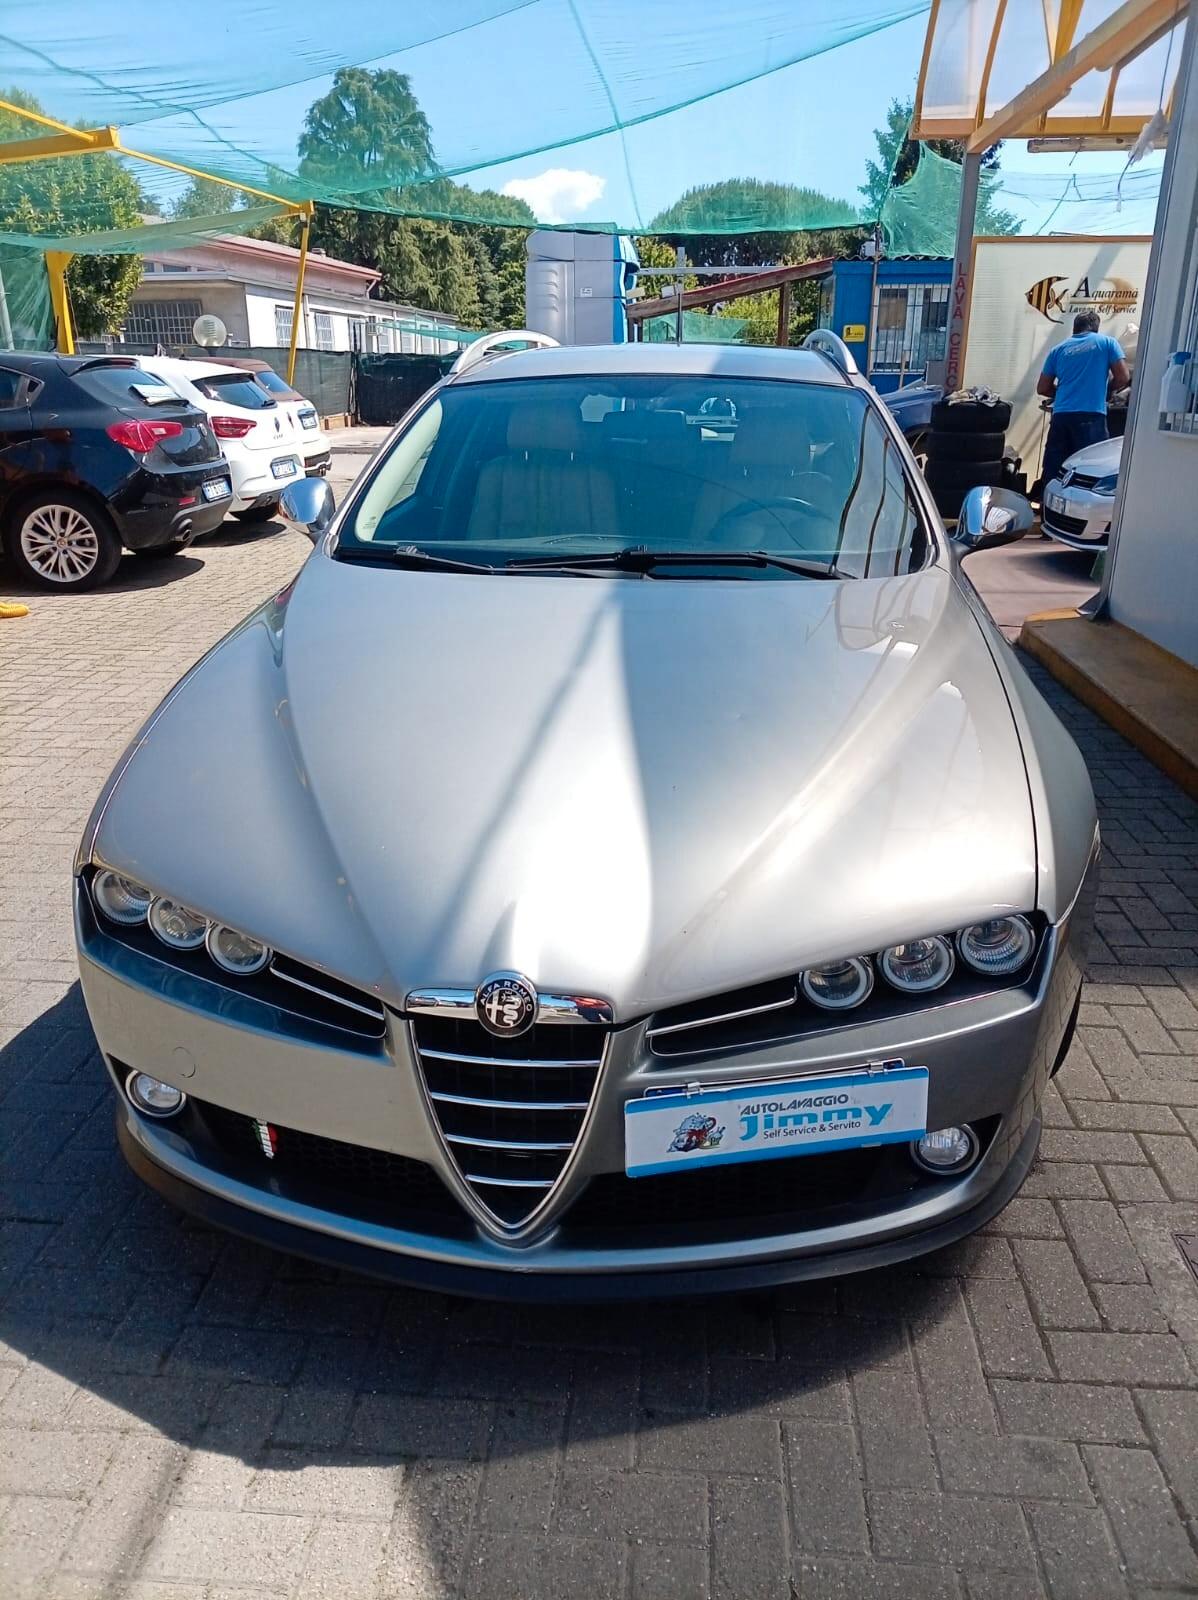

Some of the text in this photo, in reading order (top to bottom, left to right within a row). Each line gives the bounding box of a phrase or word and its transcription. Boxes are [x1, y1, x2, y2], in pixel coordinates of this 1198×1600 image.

[953, 262, 967, 319] LAVA
[1071, 276, 1139, 301] Aquarama
[1097, 304, 1112, 315] Self
[1112, 304, 1137, 313] Service
[480, 980, 533, 1012] ALFA ROMEO
[740, 1094, 849, 1116] AUTOLAVAGGIO
[763, 1121, 861, 1139] Self Service & Servito
